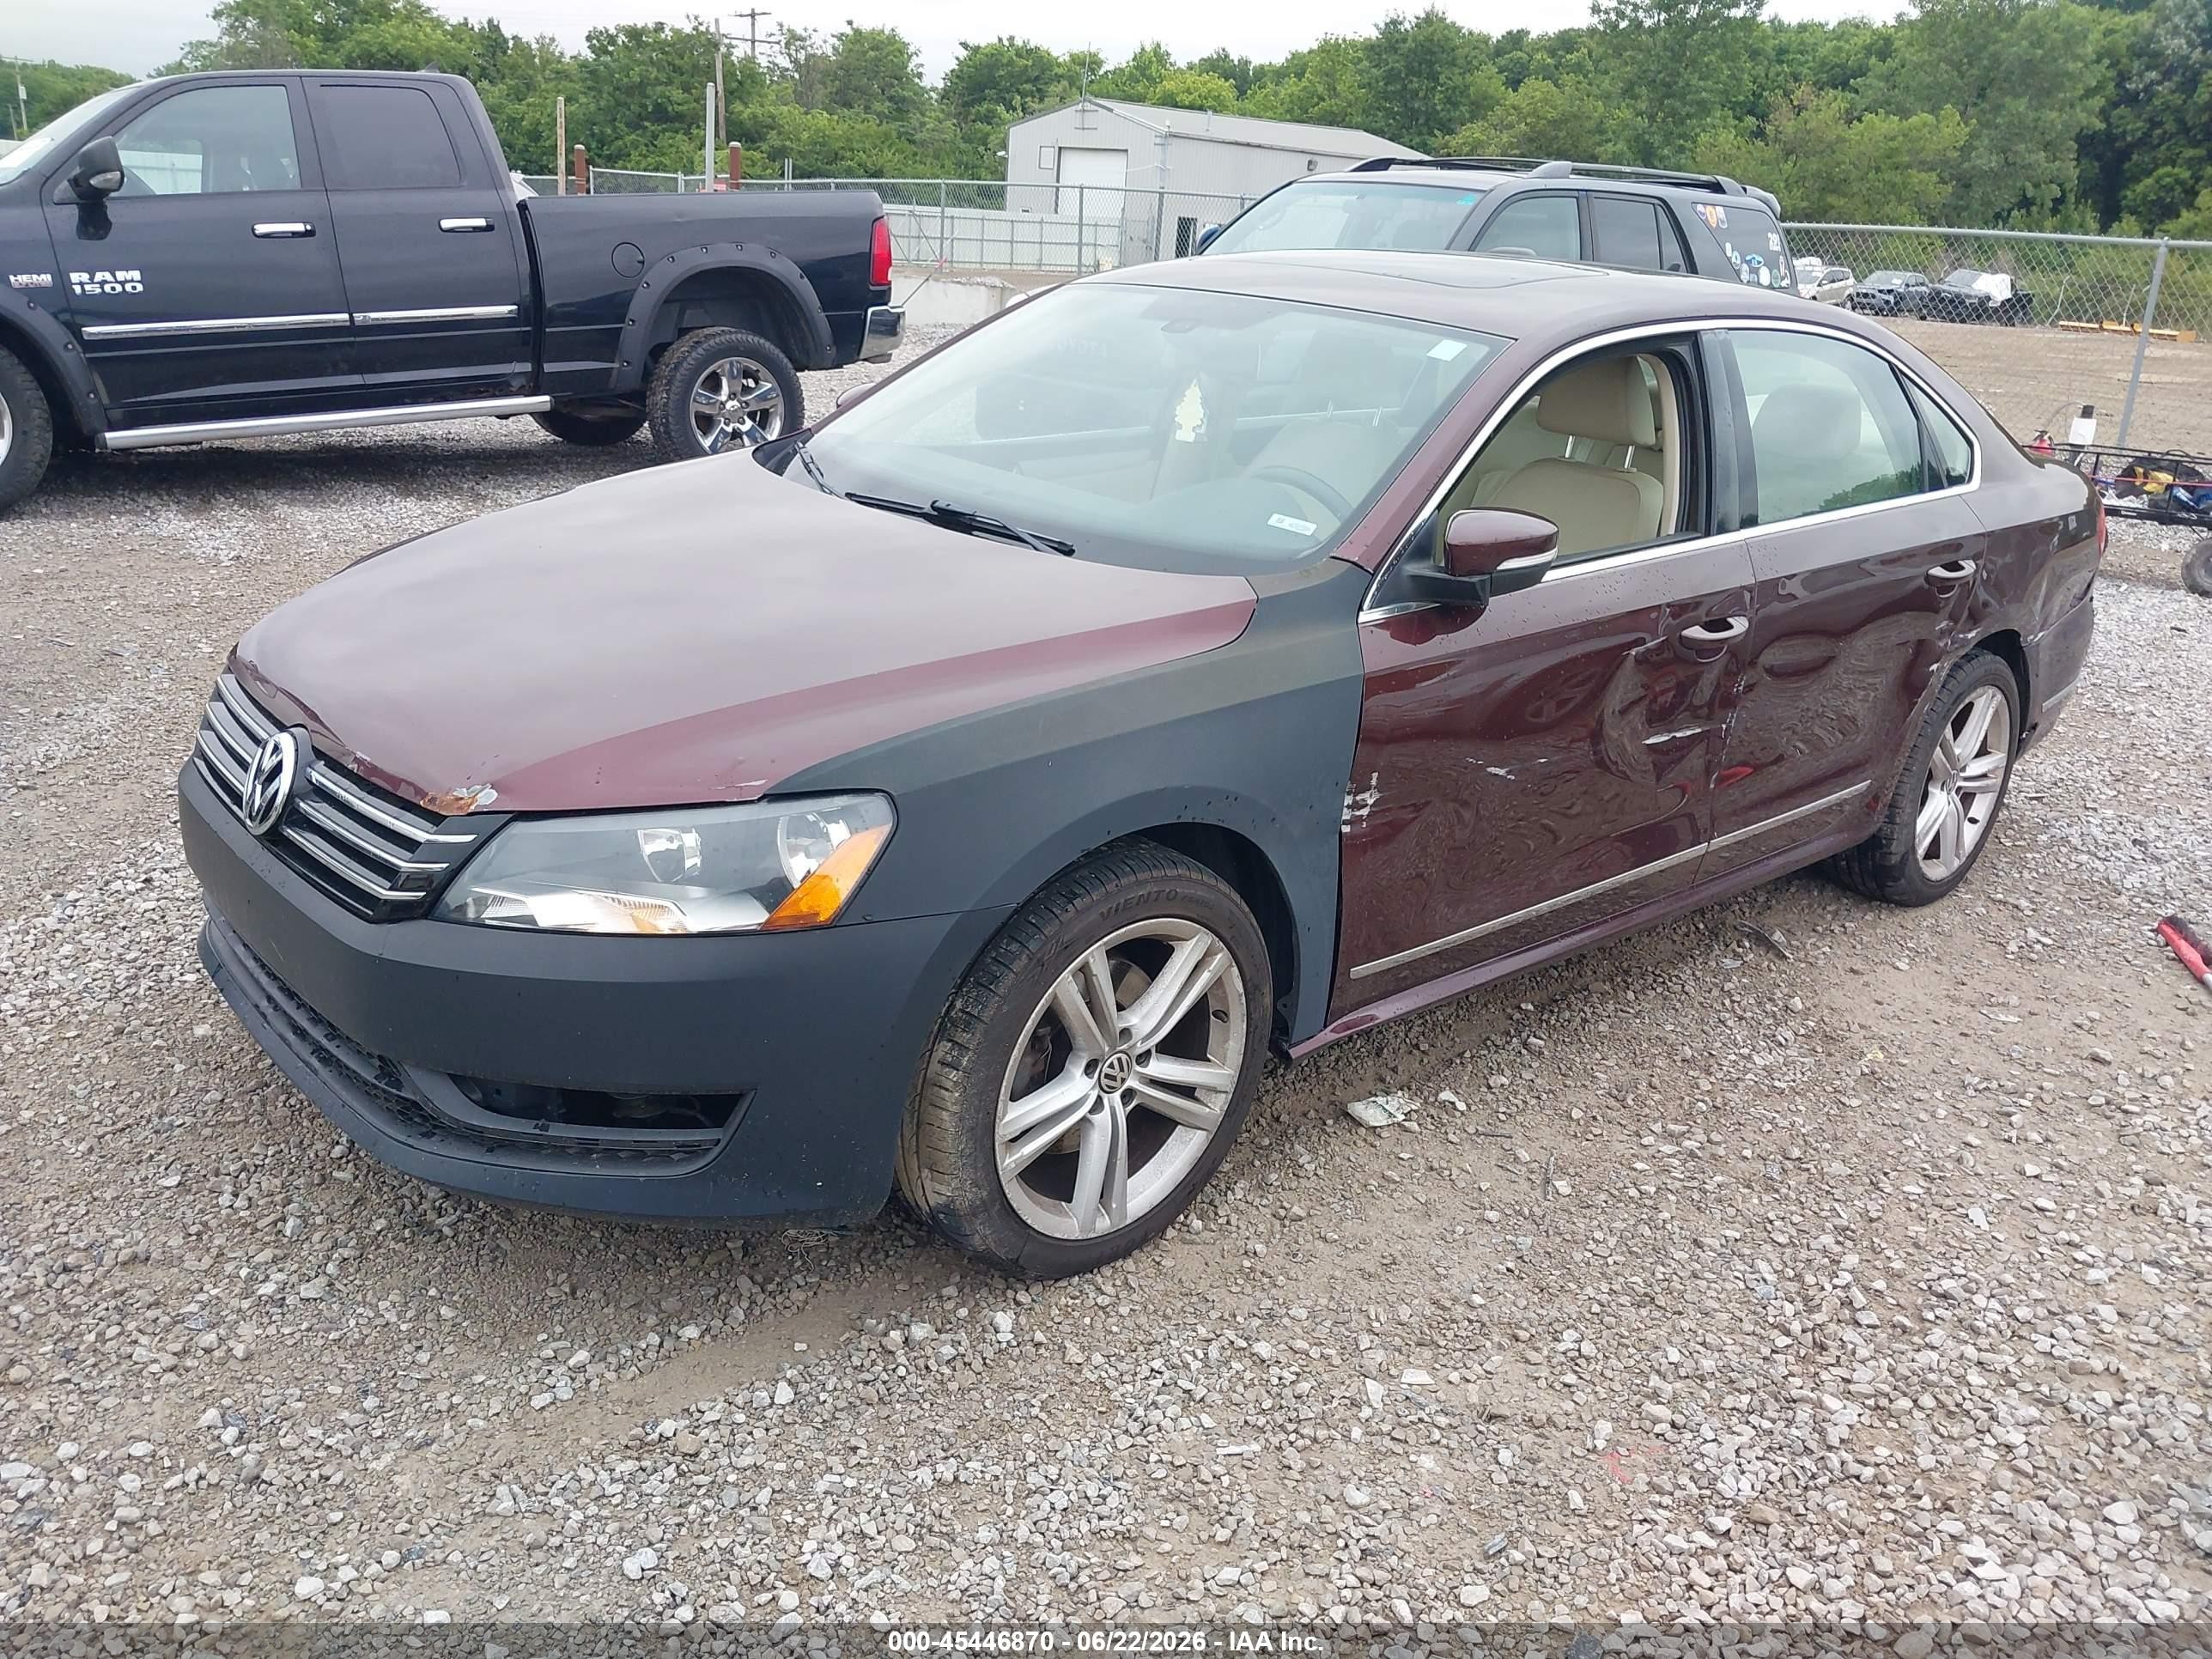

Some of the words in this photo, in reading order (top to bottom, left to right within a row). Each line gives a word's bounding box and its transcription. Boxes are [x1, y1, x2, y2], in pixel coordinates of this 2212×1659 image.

[9, 274, 52, 283] HEMI
[70, 270, 142, 283] RAM
[72, 283, 144, 295] 1500
[1100, 889, 1179, 921] VIENTO
